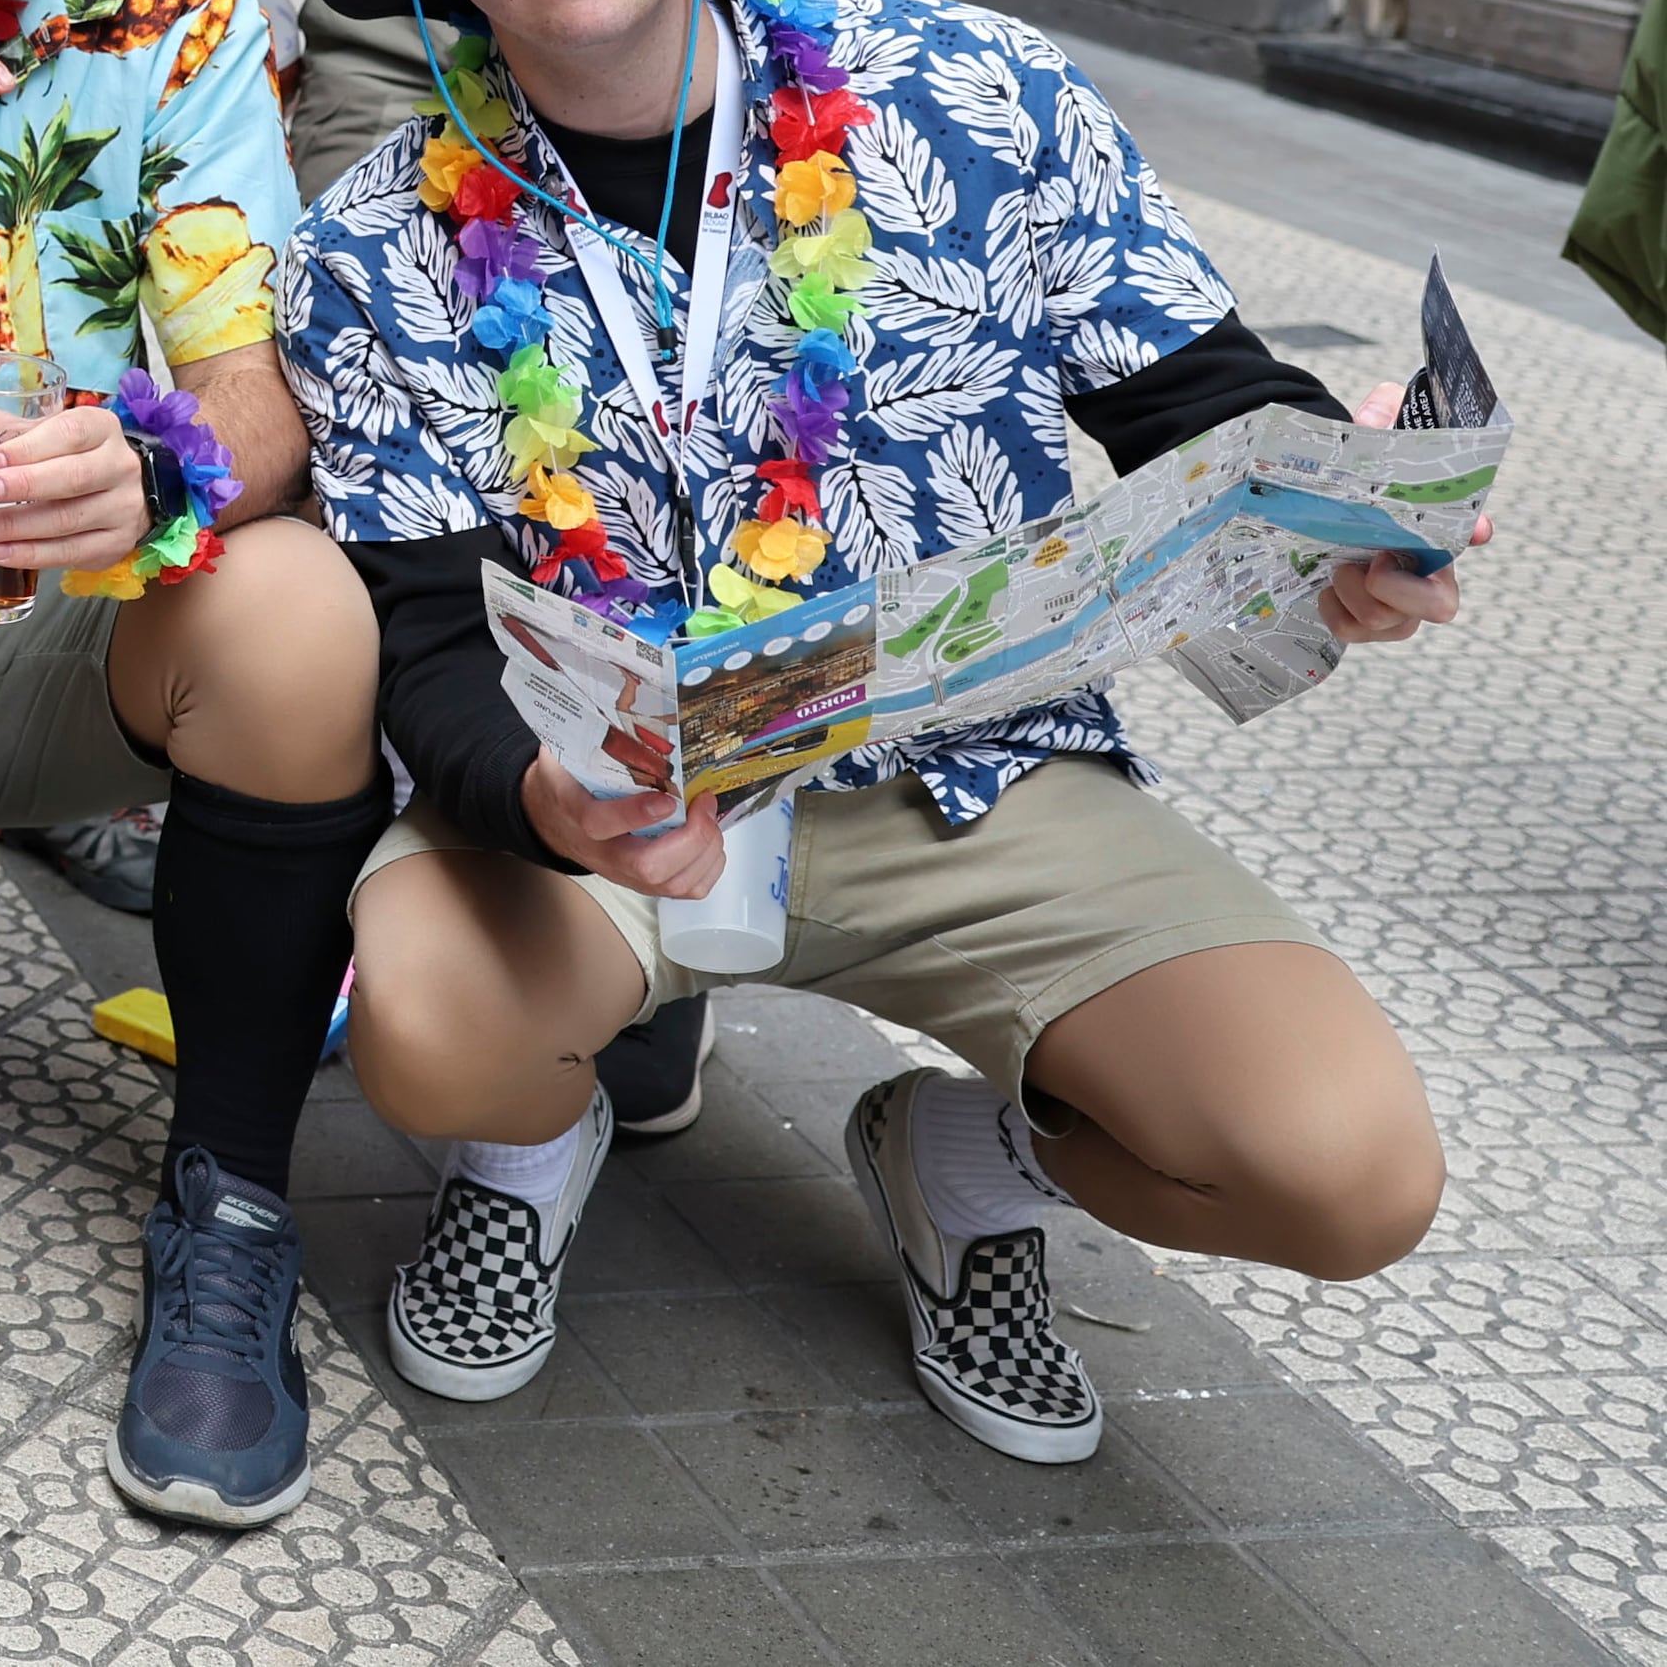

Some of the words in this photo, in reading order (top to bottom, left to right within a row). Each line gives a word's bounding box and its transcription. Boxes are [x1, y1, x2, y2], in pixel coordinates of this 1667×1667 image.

[533, 699, 567, 725] REFUND
[795, 689, 858, 720] PORTO
[221, 1194, 282, 1224] SKECHERS
